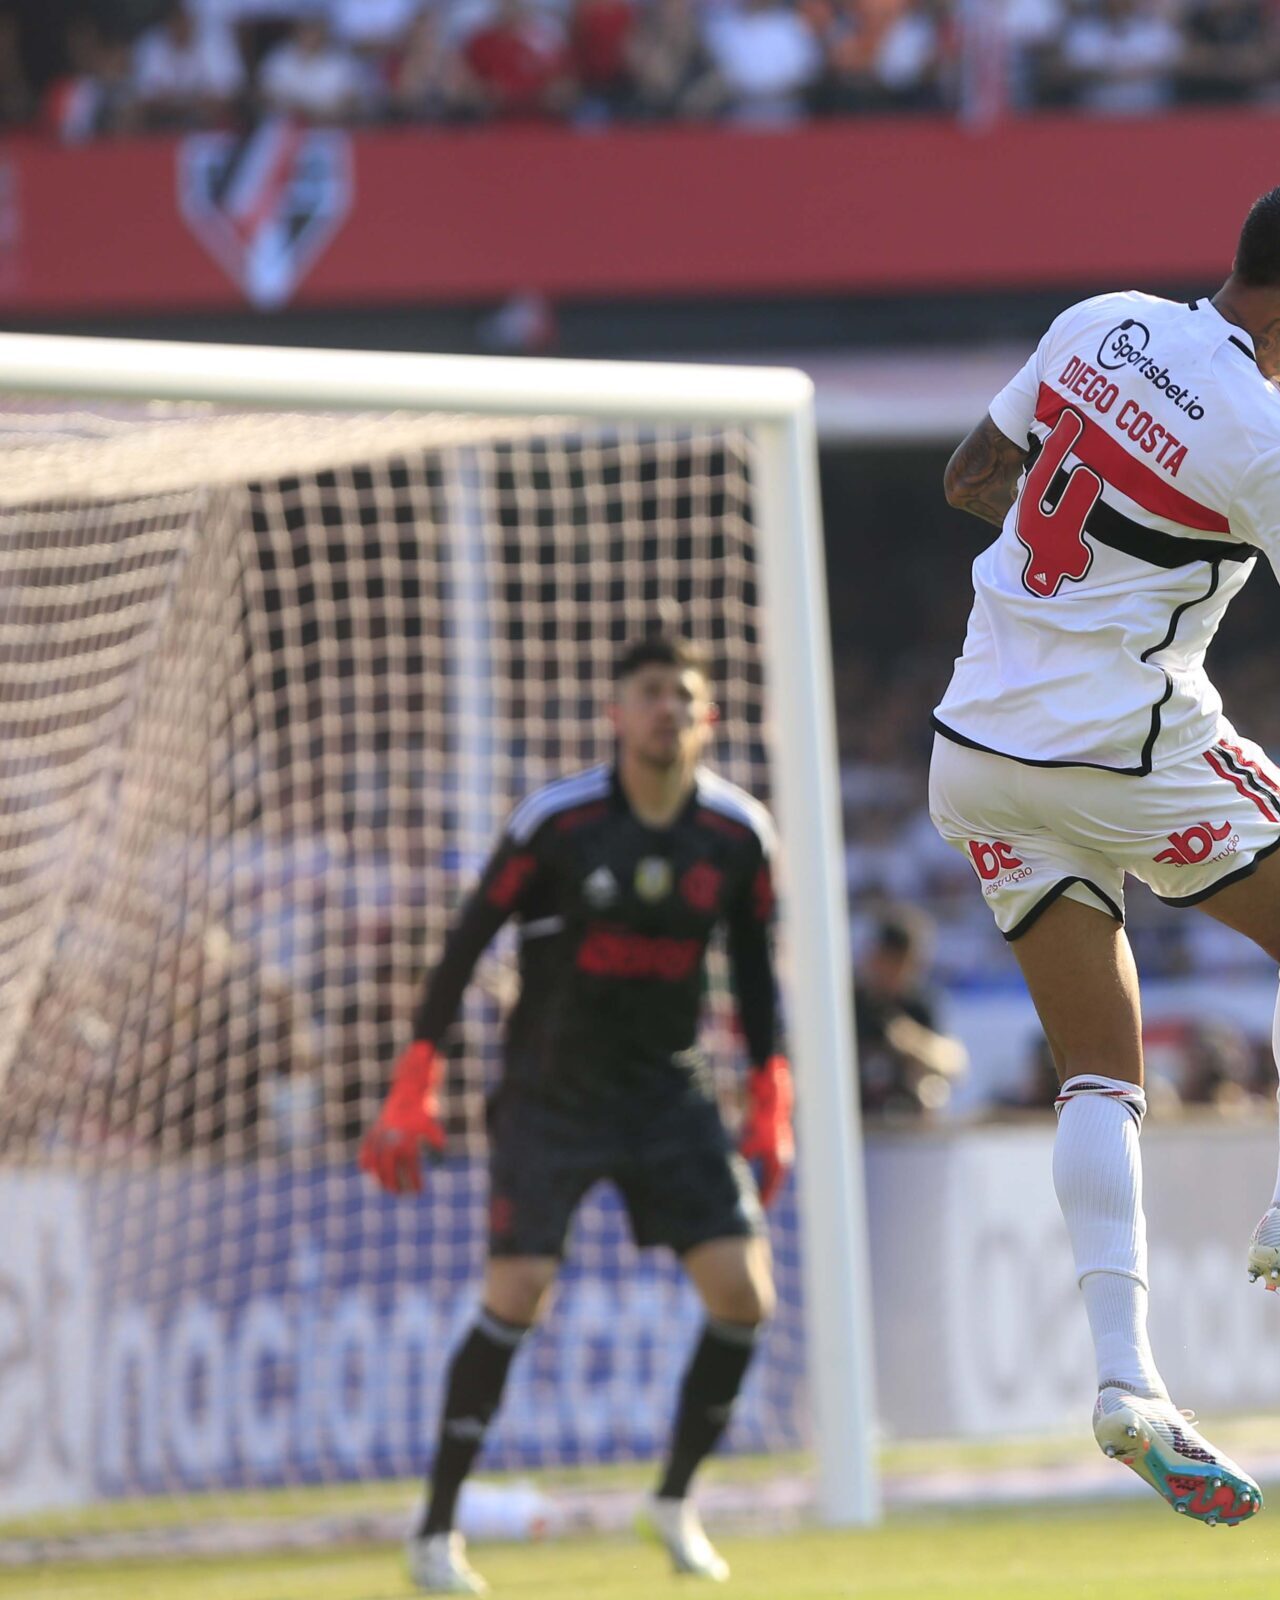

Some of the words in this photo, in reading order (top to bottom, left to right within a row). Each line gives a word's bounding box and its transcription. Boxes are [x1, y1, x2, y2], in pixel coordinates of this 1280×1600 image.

[1058, 355, 1119, 414] DIEGO
[1115, 399, 1189, 478] COSTA
[1112, 333, 1205, 421] Sportsbet.io
[1016, 406, 1104, 598] 4
